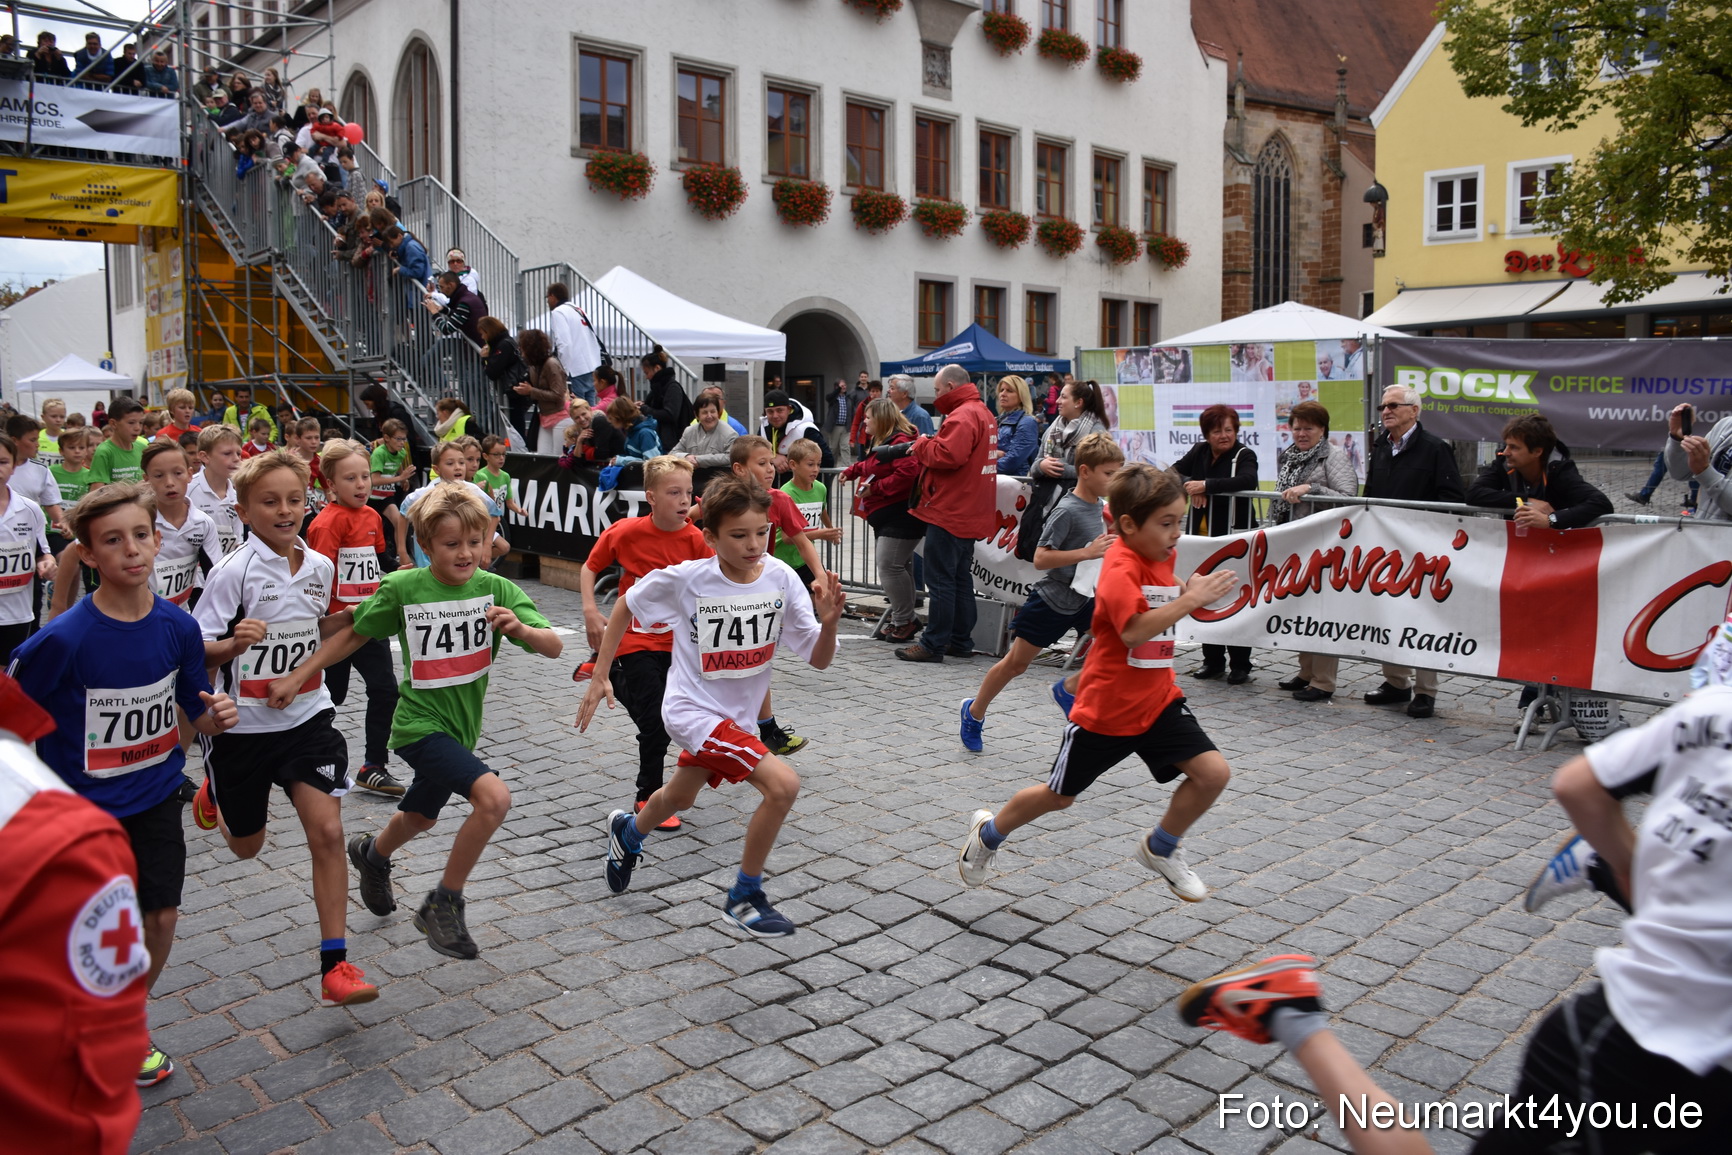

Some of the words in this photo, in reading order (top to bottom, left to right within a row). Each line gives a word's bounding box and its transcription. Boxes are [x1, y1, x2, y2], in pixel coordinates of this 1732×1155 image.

[50, 192, 107, 205] Neumarkter
[108, 196, 152, 207] Stadtlauf
[1504, 250, 1554, 274] Der
[1397, 369, 1531, 399] BOCK
[1550, 375, 1624, 393] OFFICE
[1437, 402, 1451, 414] by
[1453, 403, 1485, 414] smart
[1488, 406, 1540, 416] concepts
[1169, 430, 1205, 445] Neue
[156, 565, 176, 574] PARTL
[344, 559, 380, 581] 7164
[968, 556, 1033, 597] tbayerns
[1186, 517, 1469, 623] Charivari
[258, 593, 279, 602] Lukas
[358, 587, 374, 595] Luca
[408, 611, 437, 621] PARTL
[439, 607, 481, 619] Neumarkt
[699, 605, 728, 614] PARTL
[730, 602, 772, 612] Neumarkt
[278, 627, 314, 640] Neumarkt
[415, 617, 487, 656] 7418
[708, 612, 776, 648] 7417
[1266, 615, 1391, 646] Ostbayerns
[1398, 627, 1478, 656] Radio
[89, 698, 129, 707] PARTL
[131, 685, 170, 706] Neumarkt
[99, 695, 174, 744] 7006
[121, 743, 160, 764] Moritz
